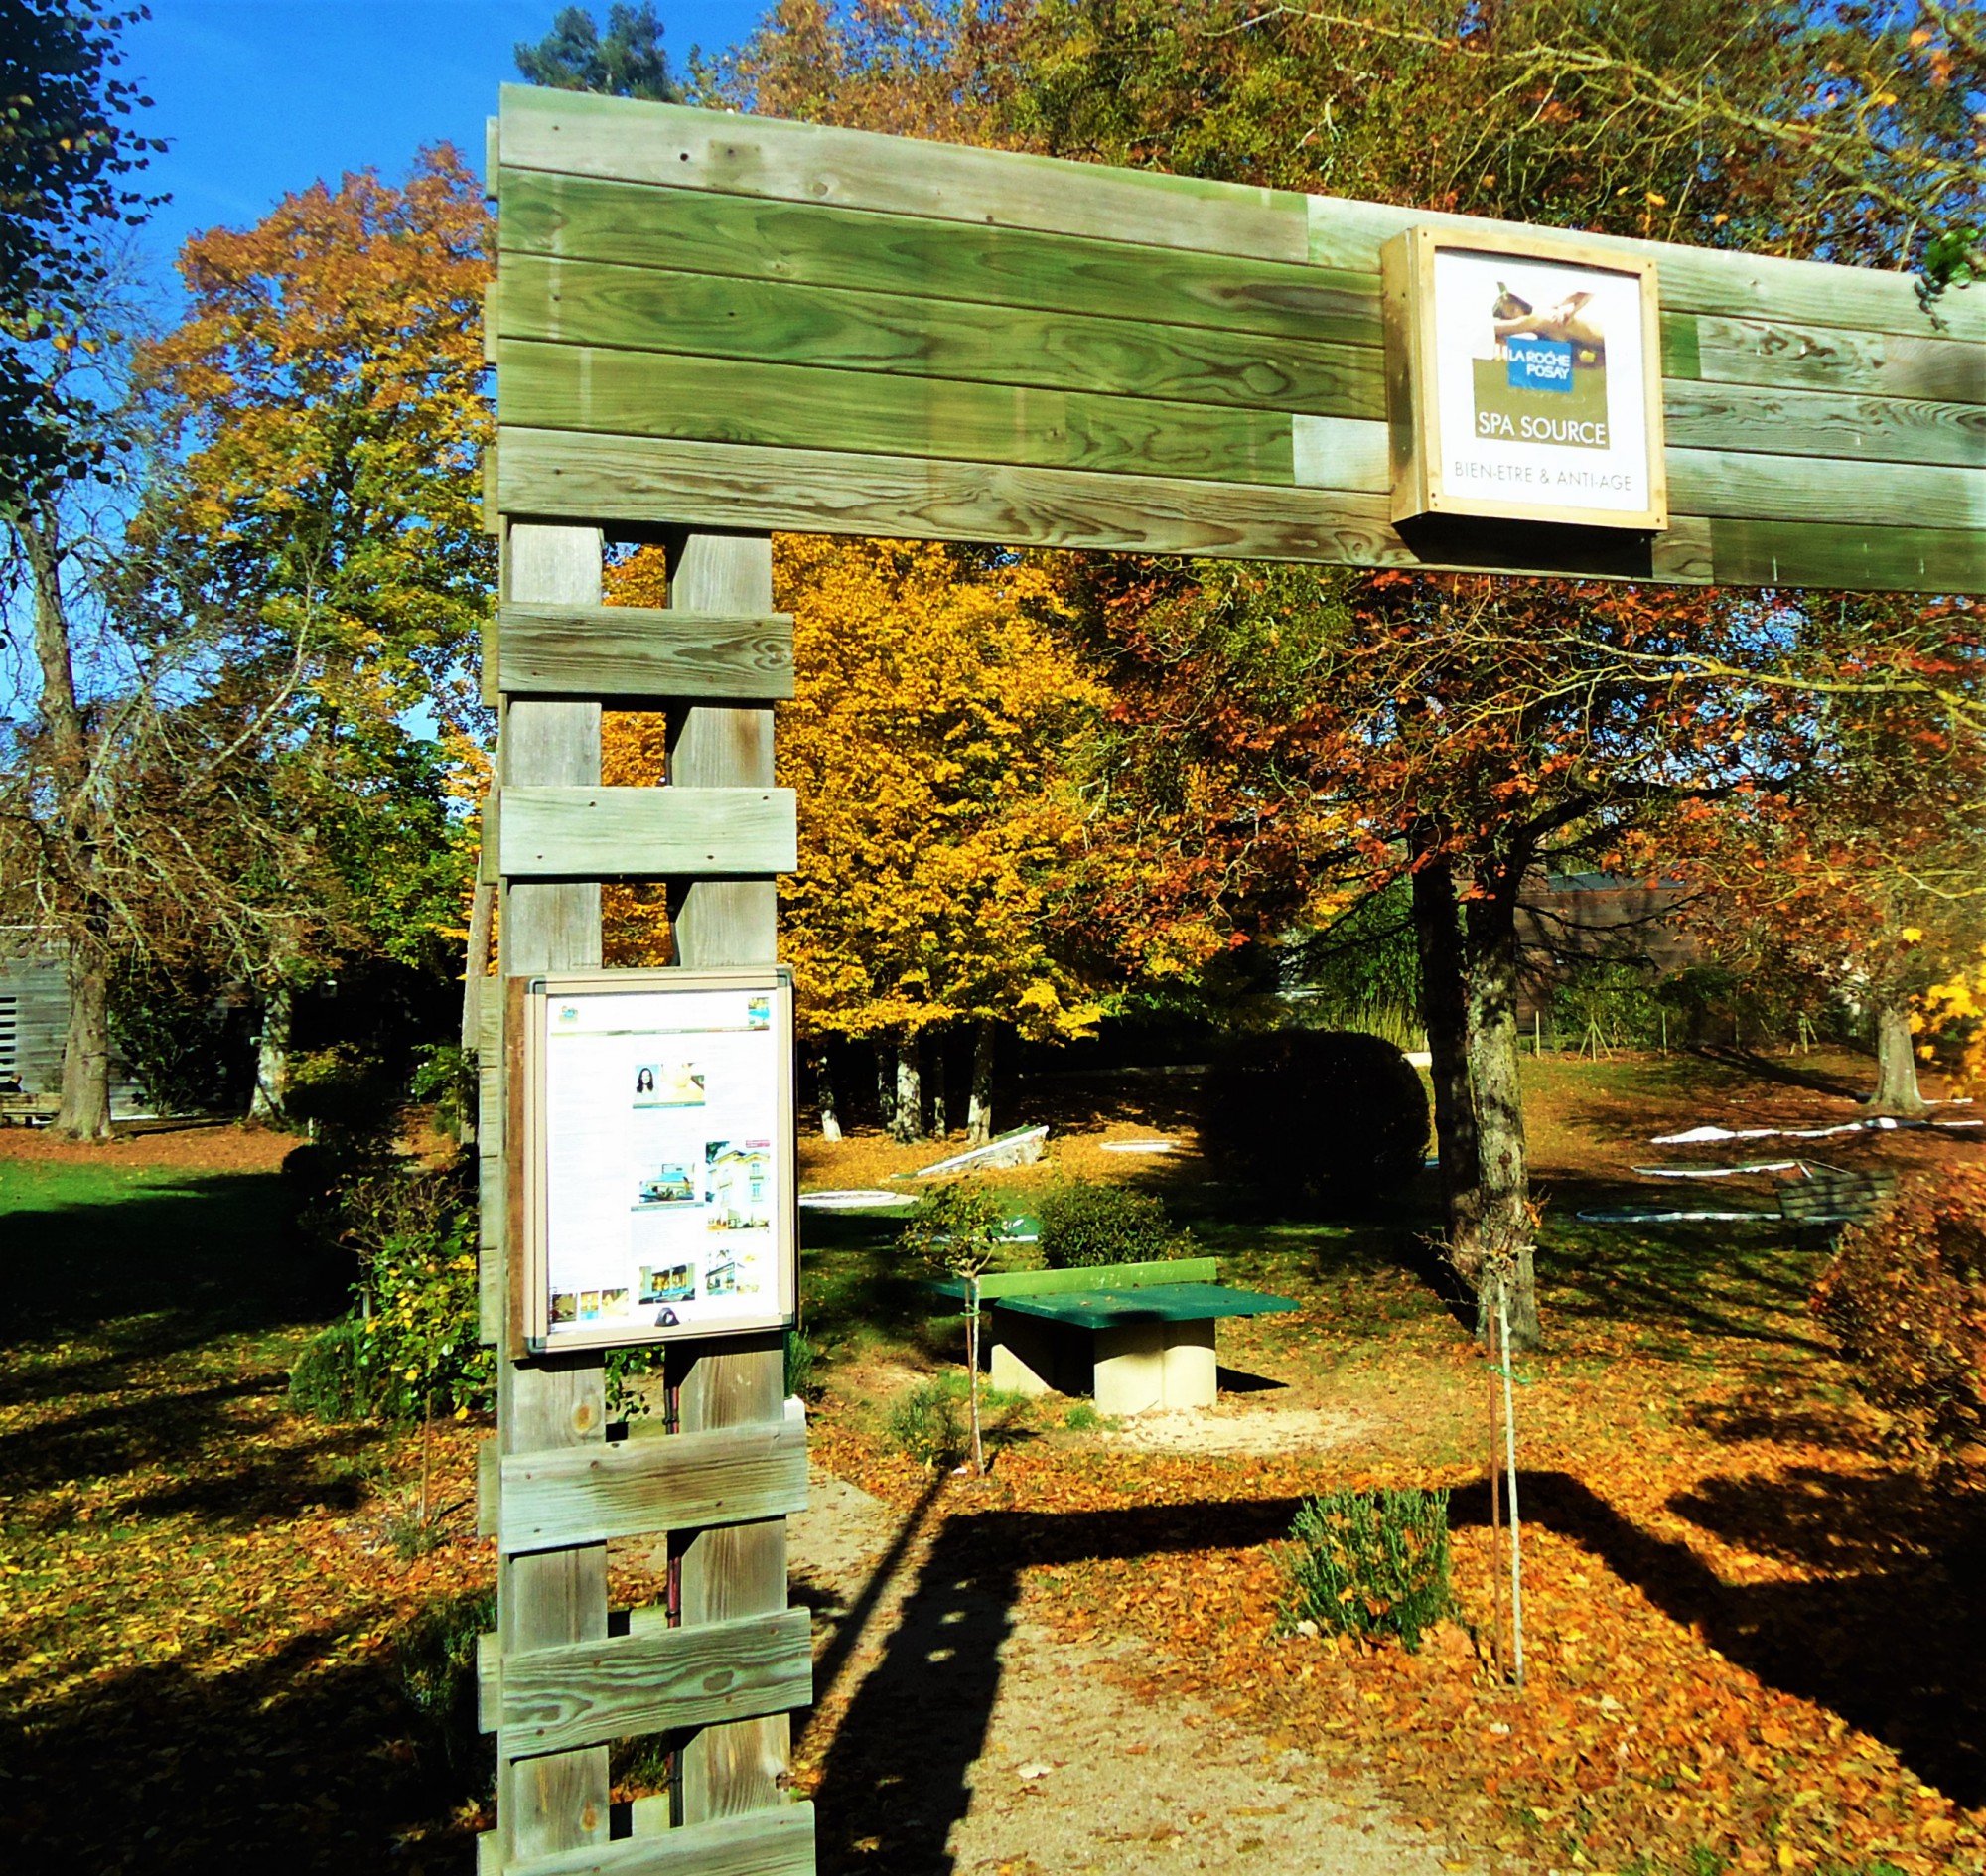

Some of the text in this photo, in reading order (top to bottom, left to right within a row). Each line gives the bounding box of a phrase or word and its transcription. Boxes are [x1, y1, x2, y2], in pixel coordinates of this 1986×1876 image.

[1509, 349, 1570, 367] LA ROCHE
[1526, 364, 1569, 379] POSAY
[1479, 412, 1606, 445] SPA SOURCE
[1540, 469, 1550, 484] &
[1557, 471, 1631, 491] ANTI-AGE
